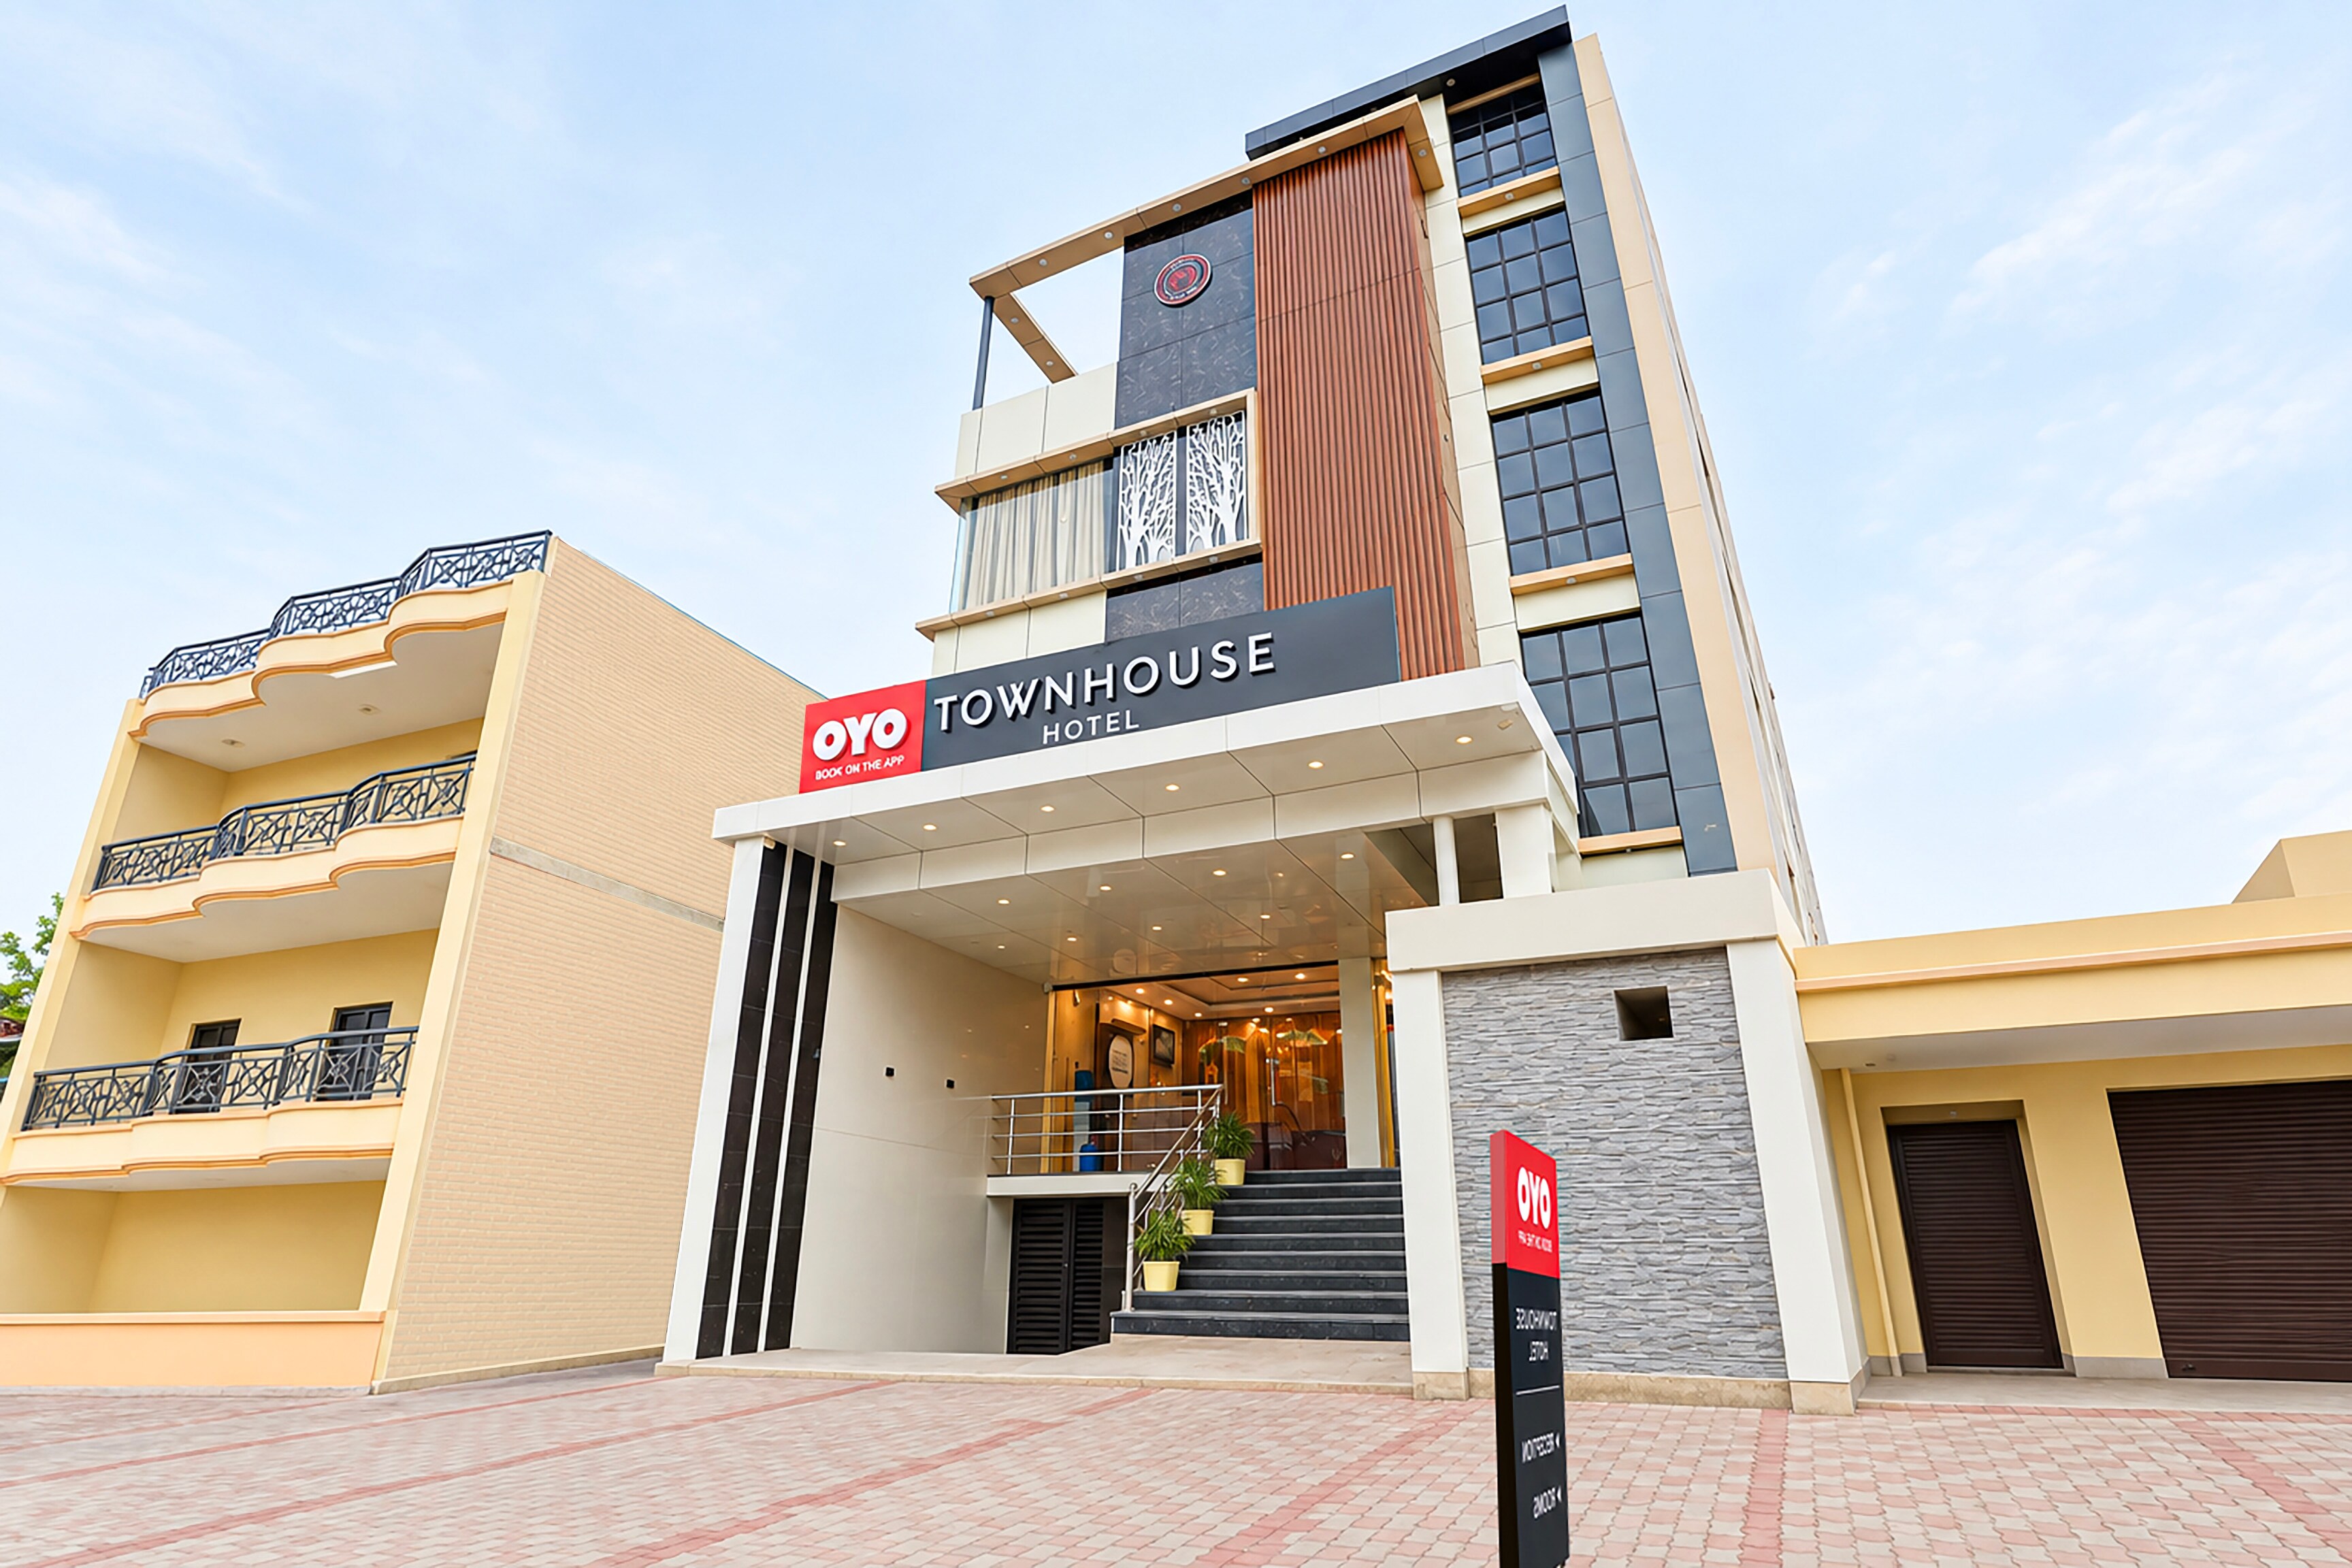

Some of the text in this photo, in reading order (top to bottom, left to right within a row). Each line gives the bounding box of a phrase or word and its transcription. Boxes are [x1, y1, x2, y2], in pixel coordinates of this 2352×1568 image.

[934, 633, 1275, 733] TOWNHOUSE
[813, 708, 909, 761] OYO
[1043, 710, 1139, 745] HOTEL
[815, 755, 904, 781] BOOK ON THE APP
